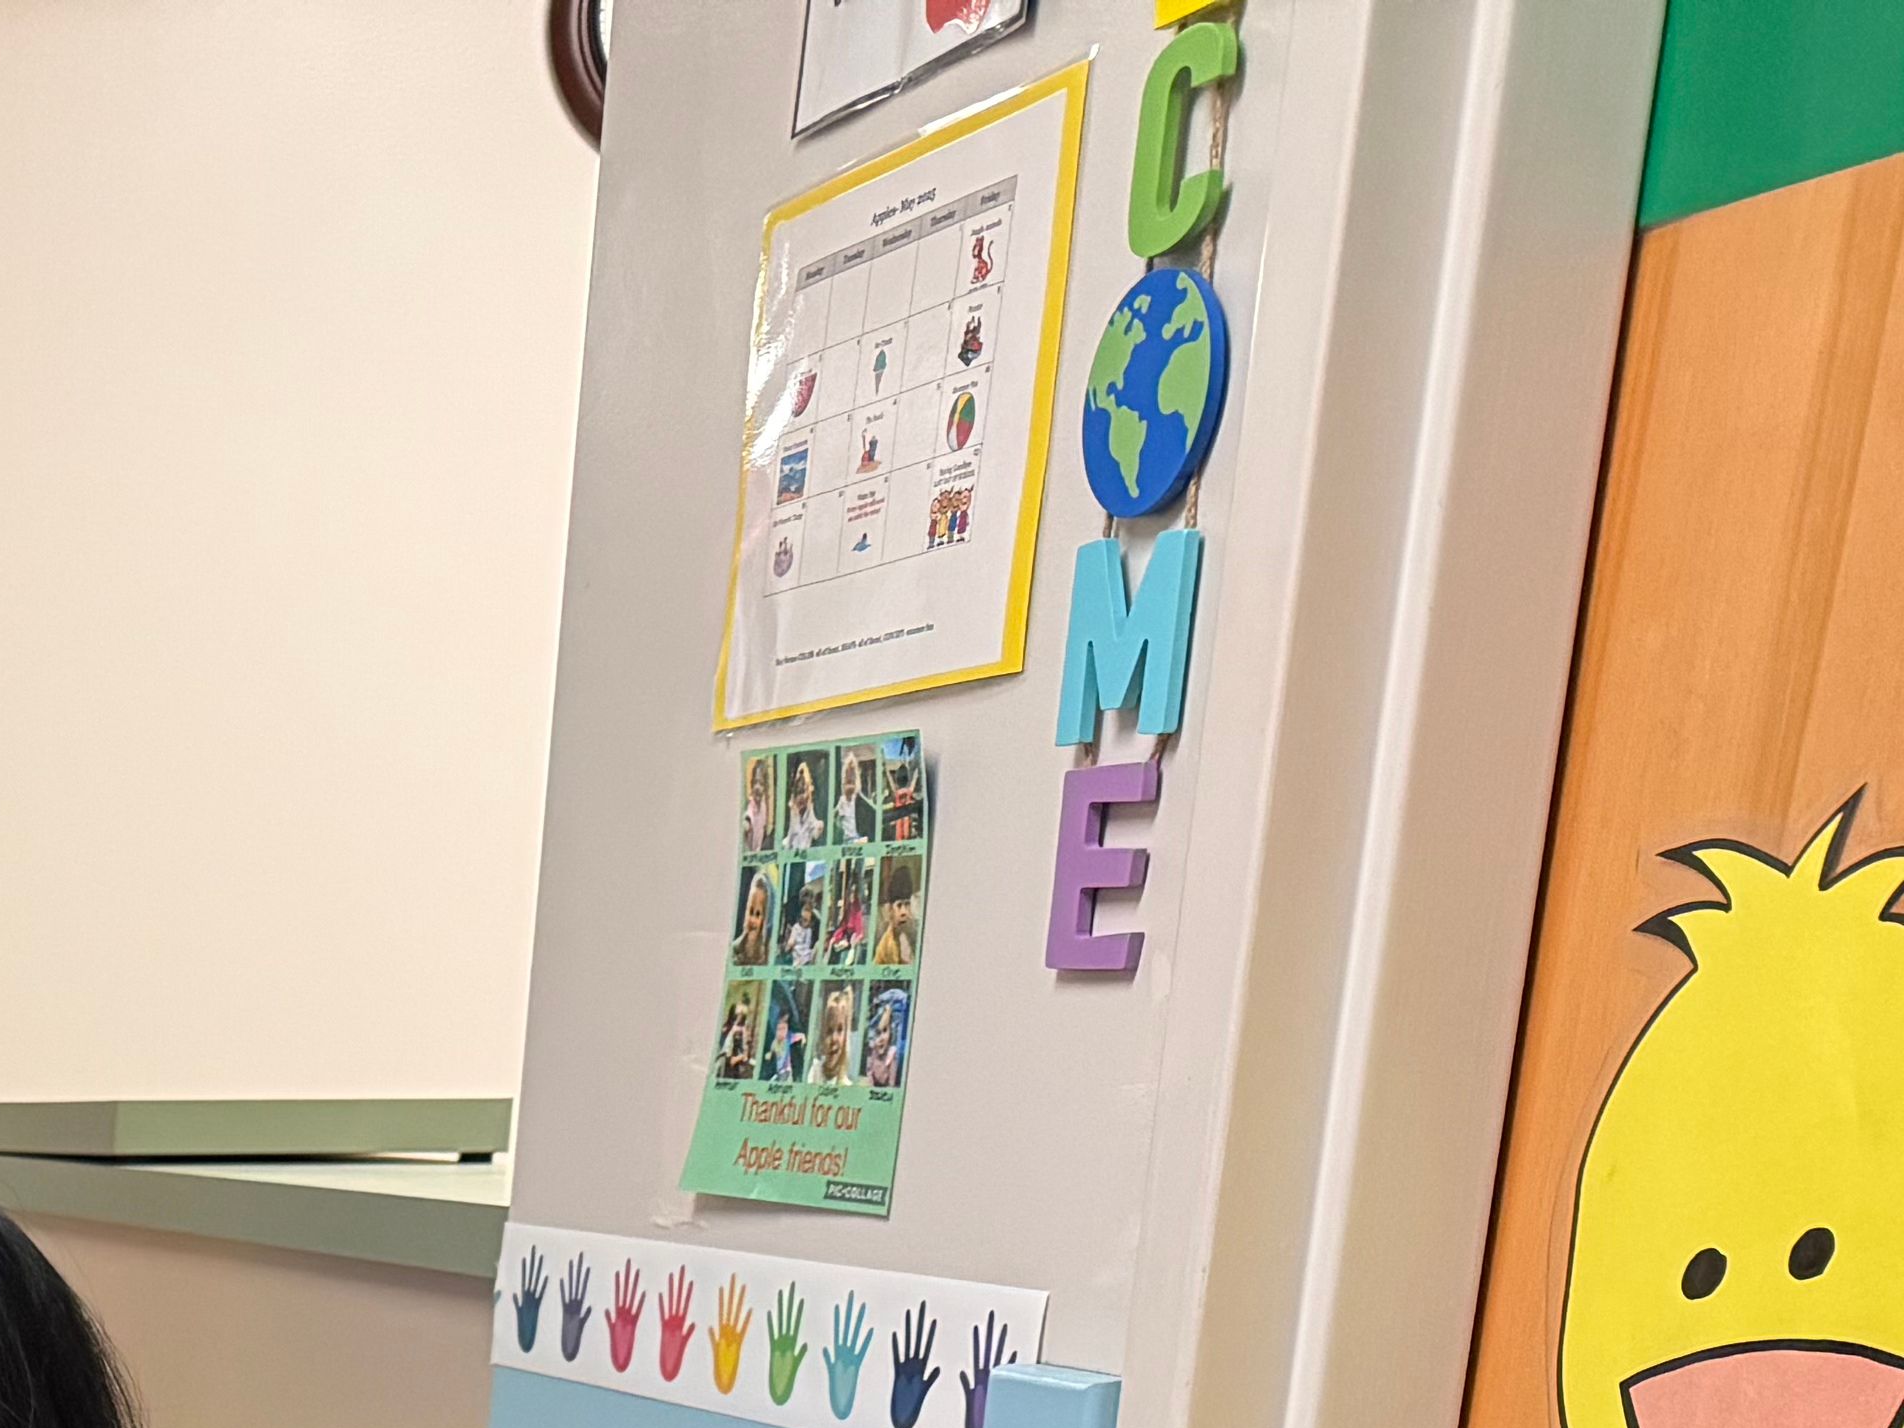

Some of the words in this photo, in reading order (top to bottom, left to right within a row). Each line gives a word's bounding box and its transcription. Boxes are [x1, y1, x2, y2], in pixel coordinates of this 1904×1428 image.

[740, 1091, 808, 1126] Thankful
[809, 1095, 832, 1128] for
[834, 1103, 863, 1131] our
[732, 1137, 784, 1176] Apple
[786, 1141, 850, 1178] friends!
